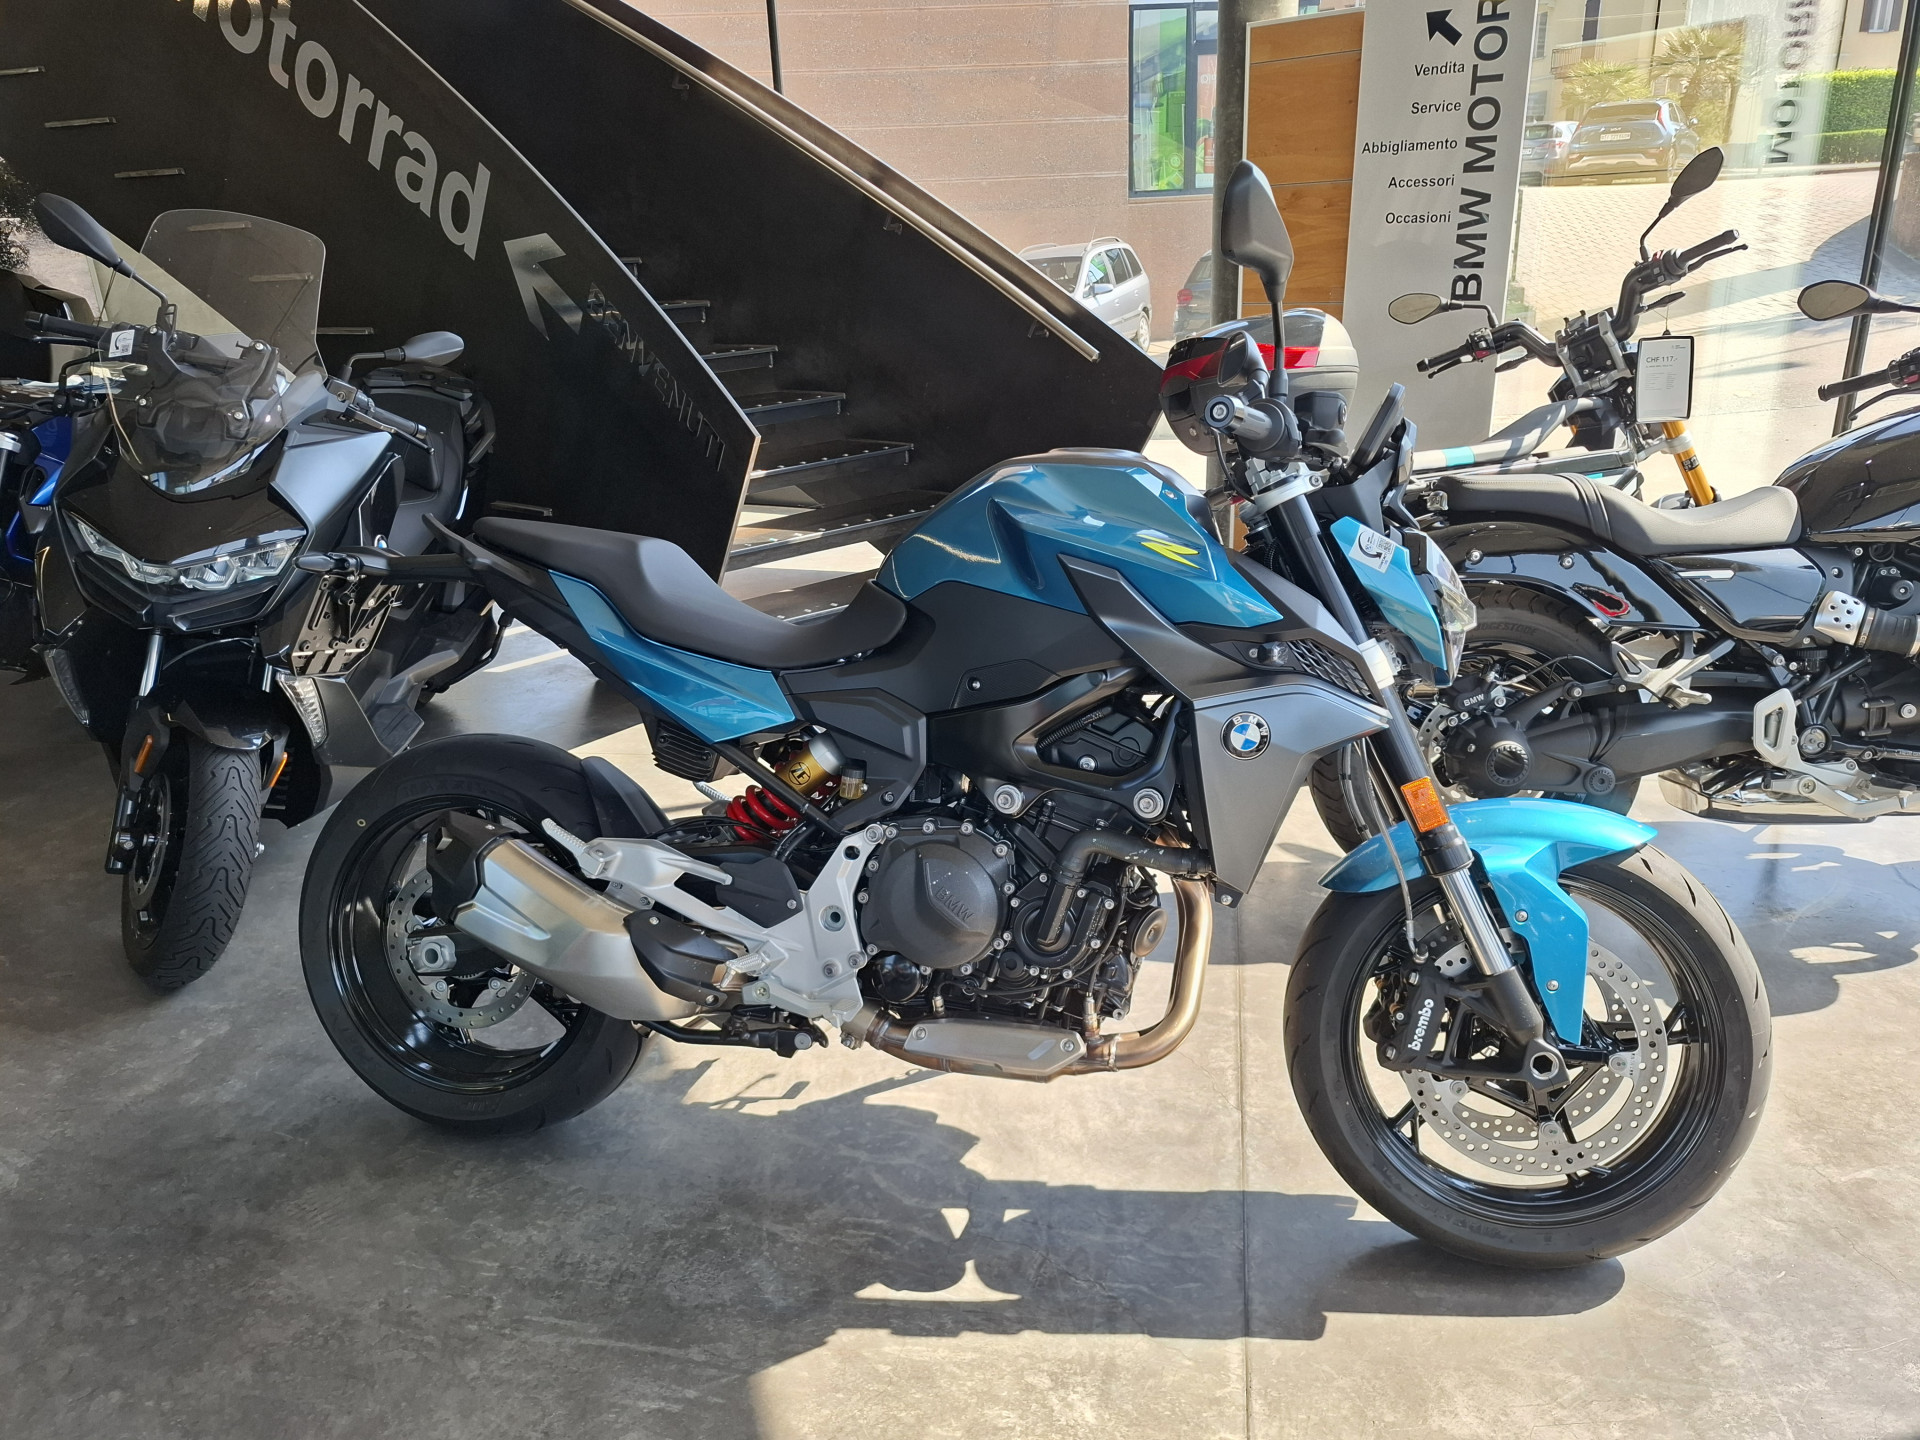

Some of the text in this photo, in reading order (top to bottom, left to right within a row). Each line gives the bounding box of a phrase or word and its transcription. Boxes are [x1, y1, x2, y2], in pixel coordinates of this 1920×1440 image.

[1414, 61, 1465, 77] Vendita
[1411, 101, 1461, 114] Service
[180, 0, 490, 260] otorrad
[1361, 138, 1458, 156] Abbigliamento
[1387, 174, 1455, 189] Accessori
[1385, 211, 1451, 225] Occasioni
[1451, 187, 1492, 302] BMW
[1645, 356, 1660, 364] CHF
[1463, 693, 1484, 707] BMW
[1232, 715, 1268, 736] BMW
[935, 886, 976, 922] BMW
[1407, 998, 1434, 1051] brembo
